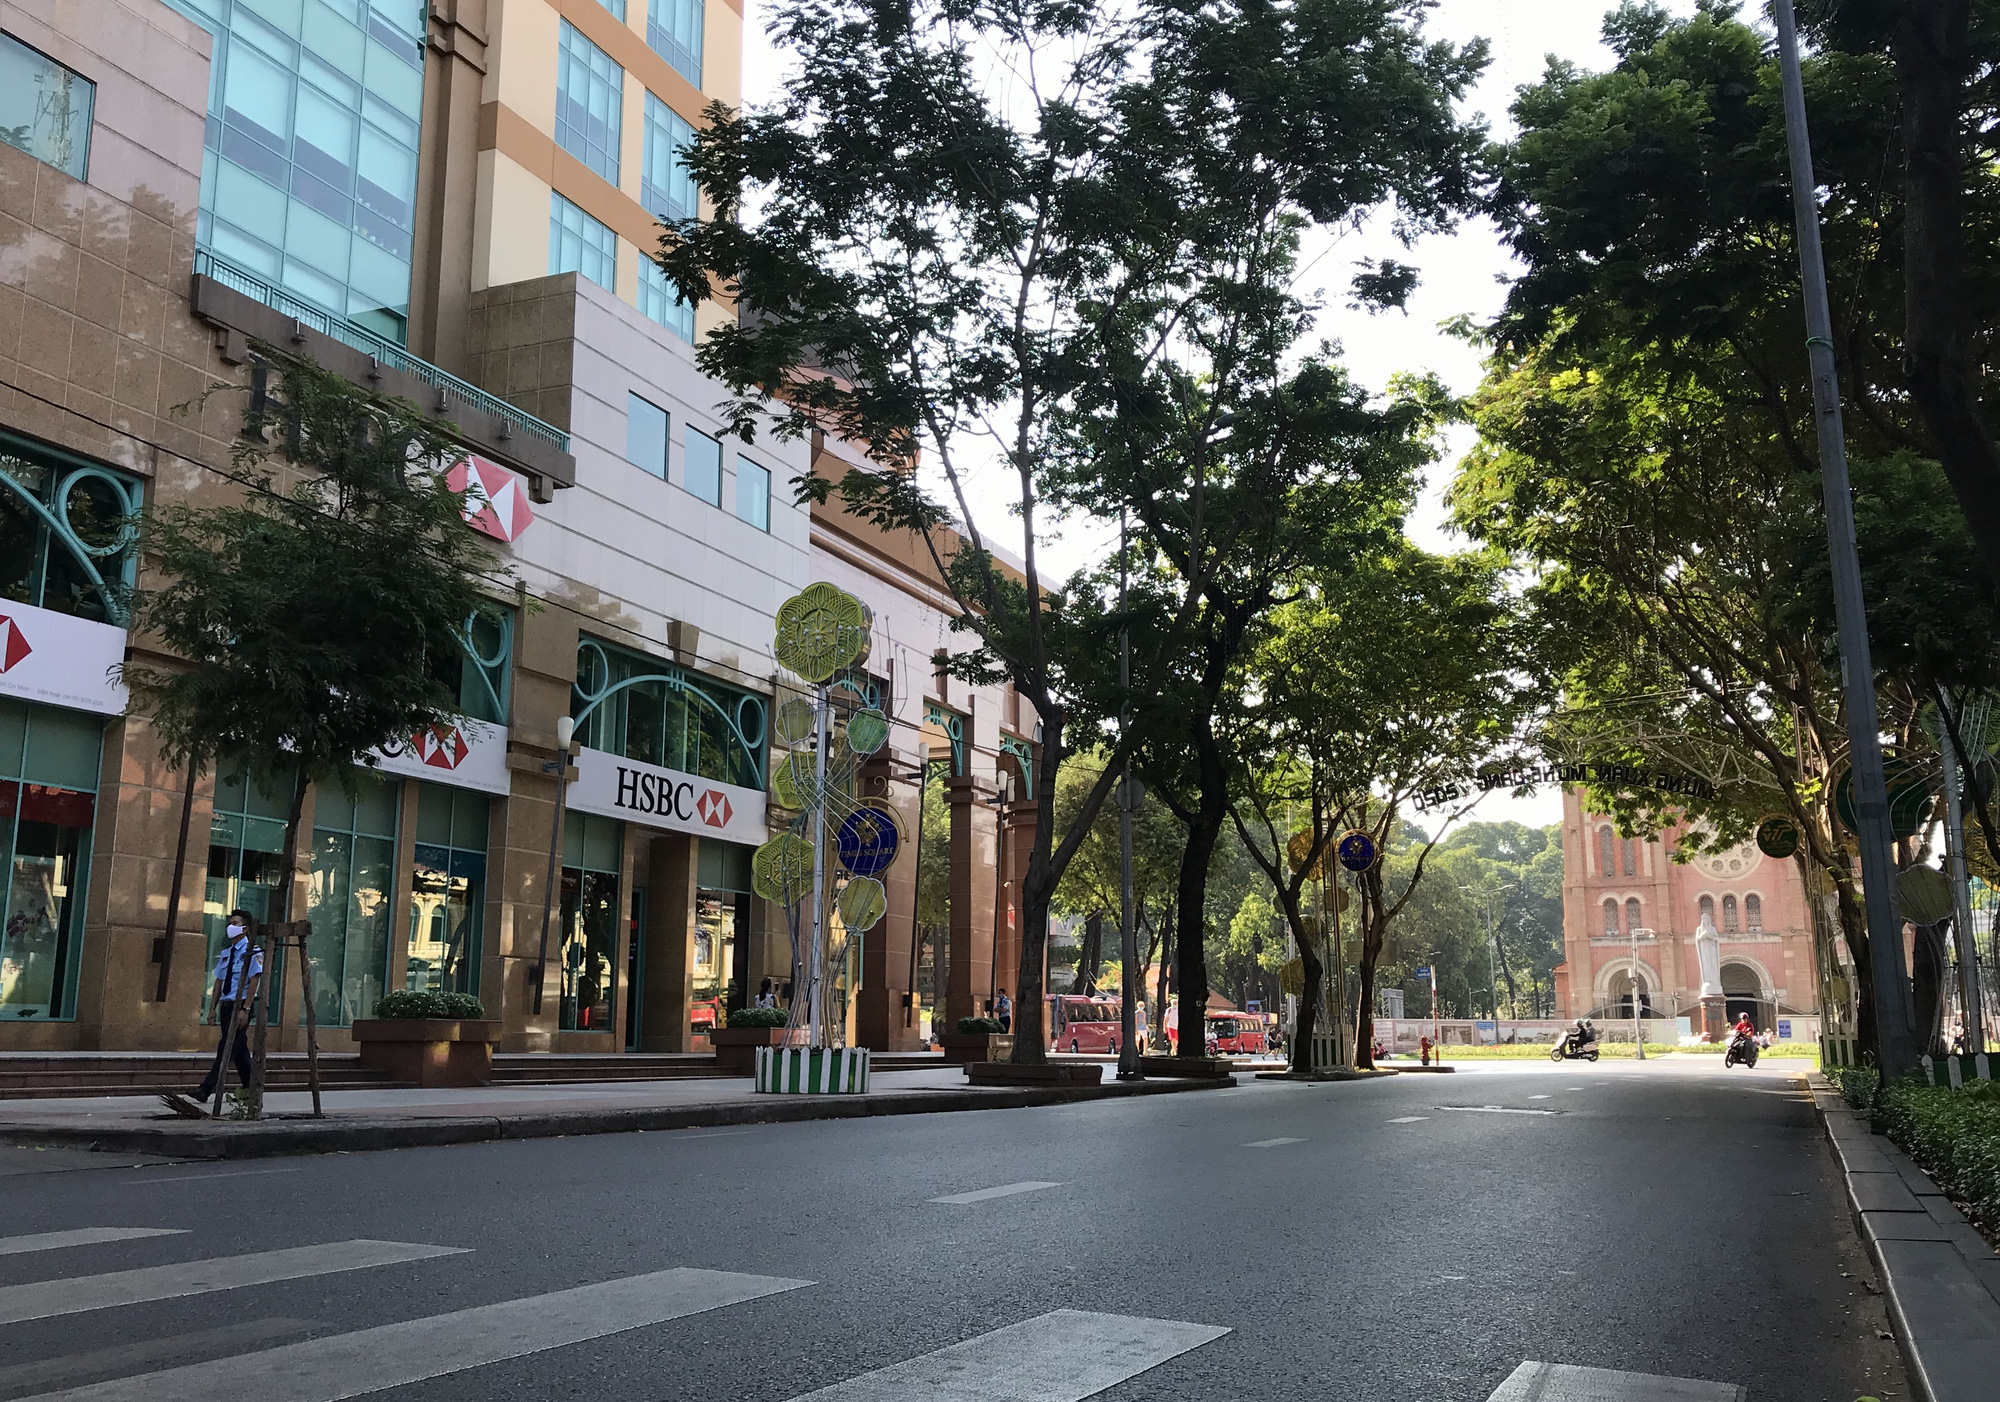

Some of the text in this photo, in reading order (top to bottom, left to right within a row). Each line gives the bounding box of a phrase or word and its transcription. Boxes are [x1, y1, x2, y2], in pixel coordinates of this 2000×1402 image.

[614, 765, 695, 821] HSBC
[840, 847, 894, 858] TIMES SQUARE
